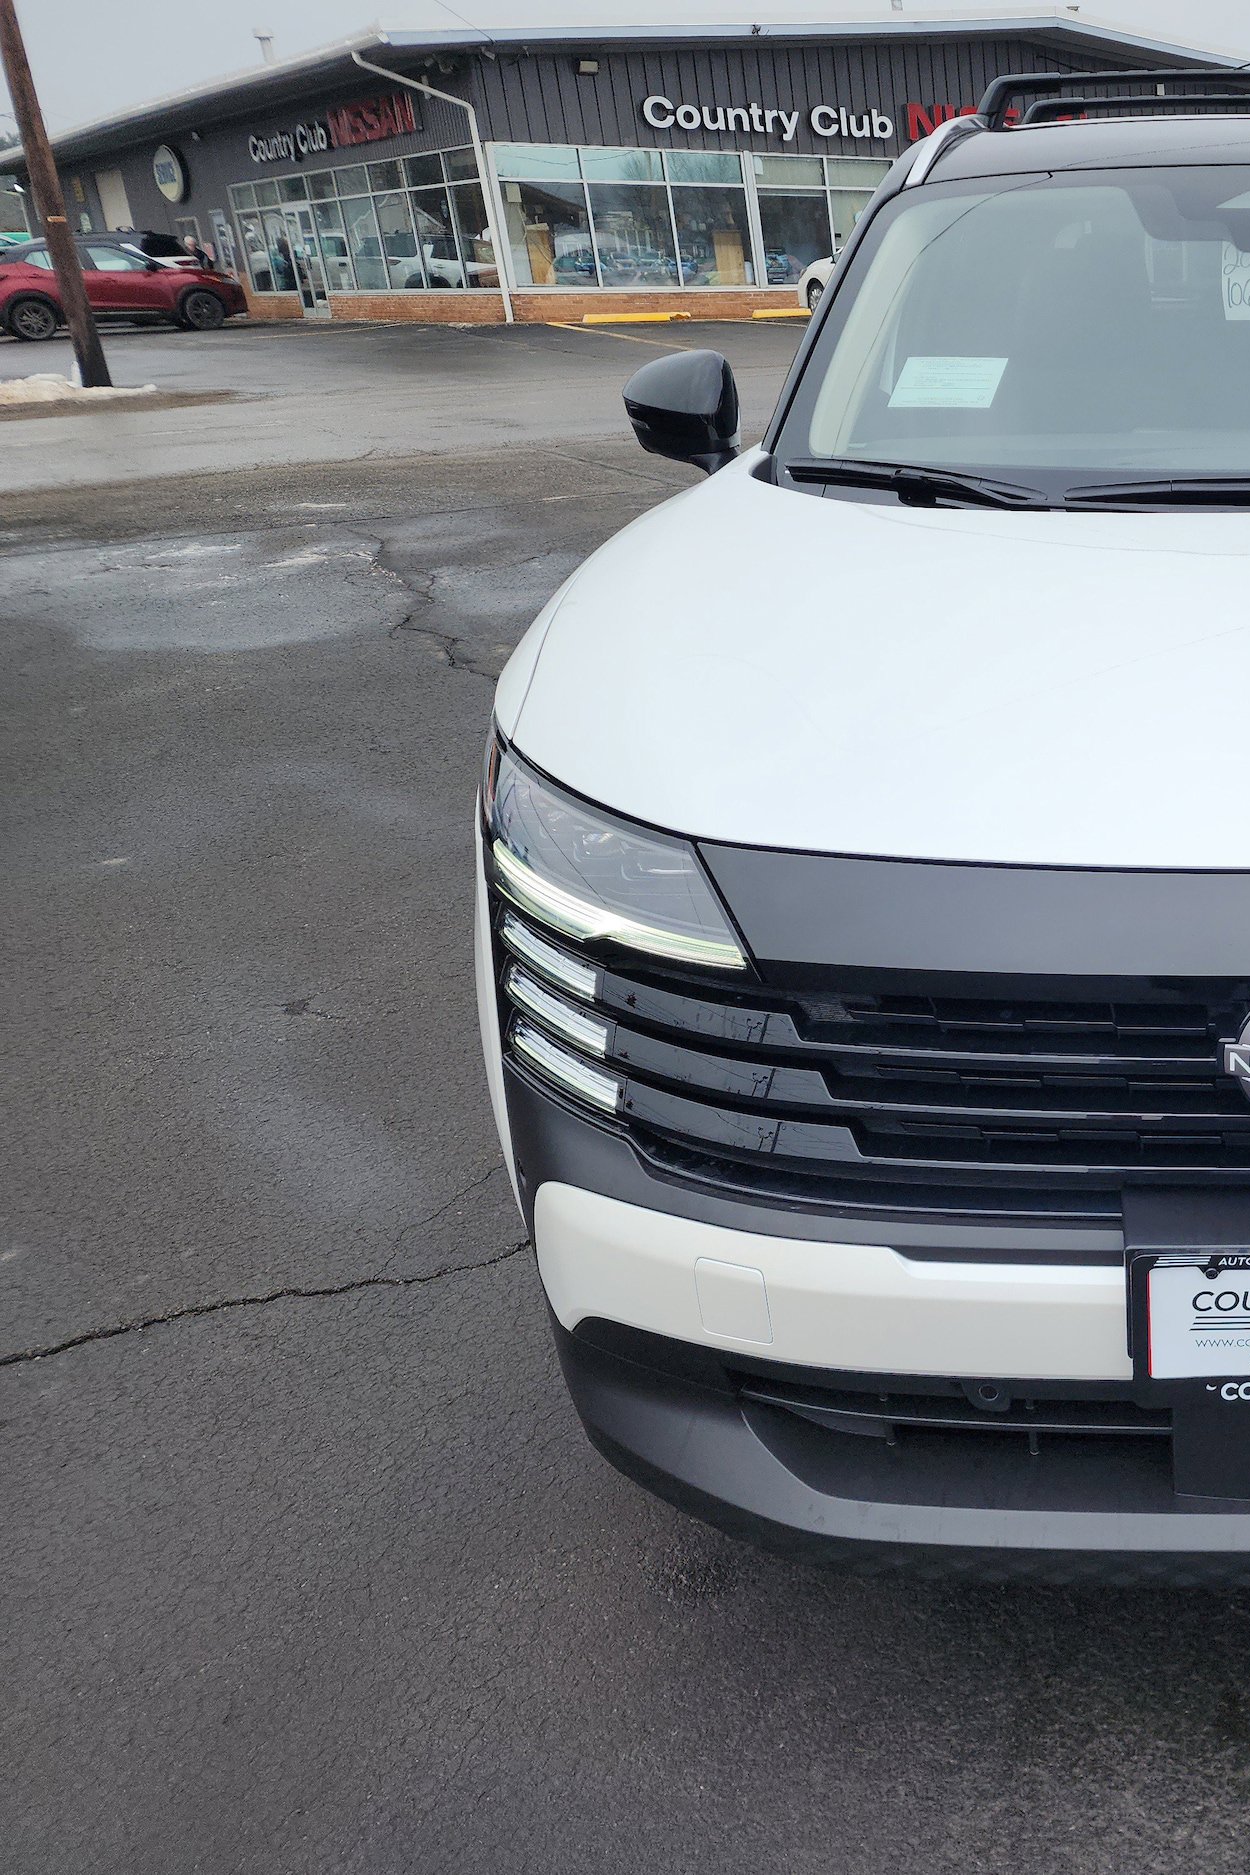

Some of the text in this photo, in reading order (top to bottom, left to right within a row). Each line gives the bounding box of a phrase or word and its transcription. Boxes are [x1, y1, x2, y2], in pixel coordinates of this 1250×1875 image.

[248, 91, 417, 163] Country Club NISSAN
[643, 95, 800, 141] Country
[810, 105, 894, 139] Club
